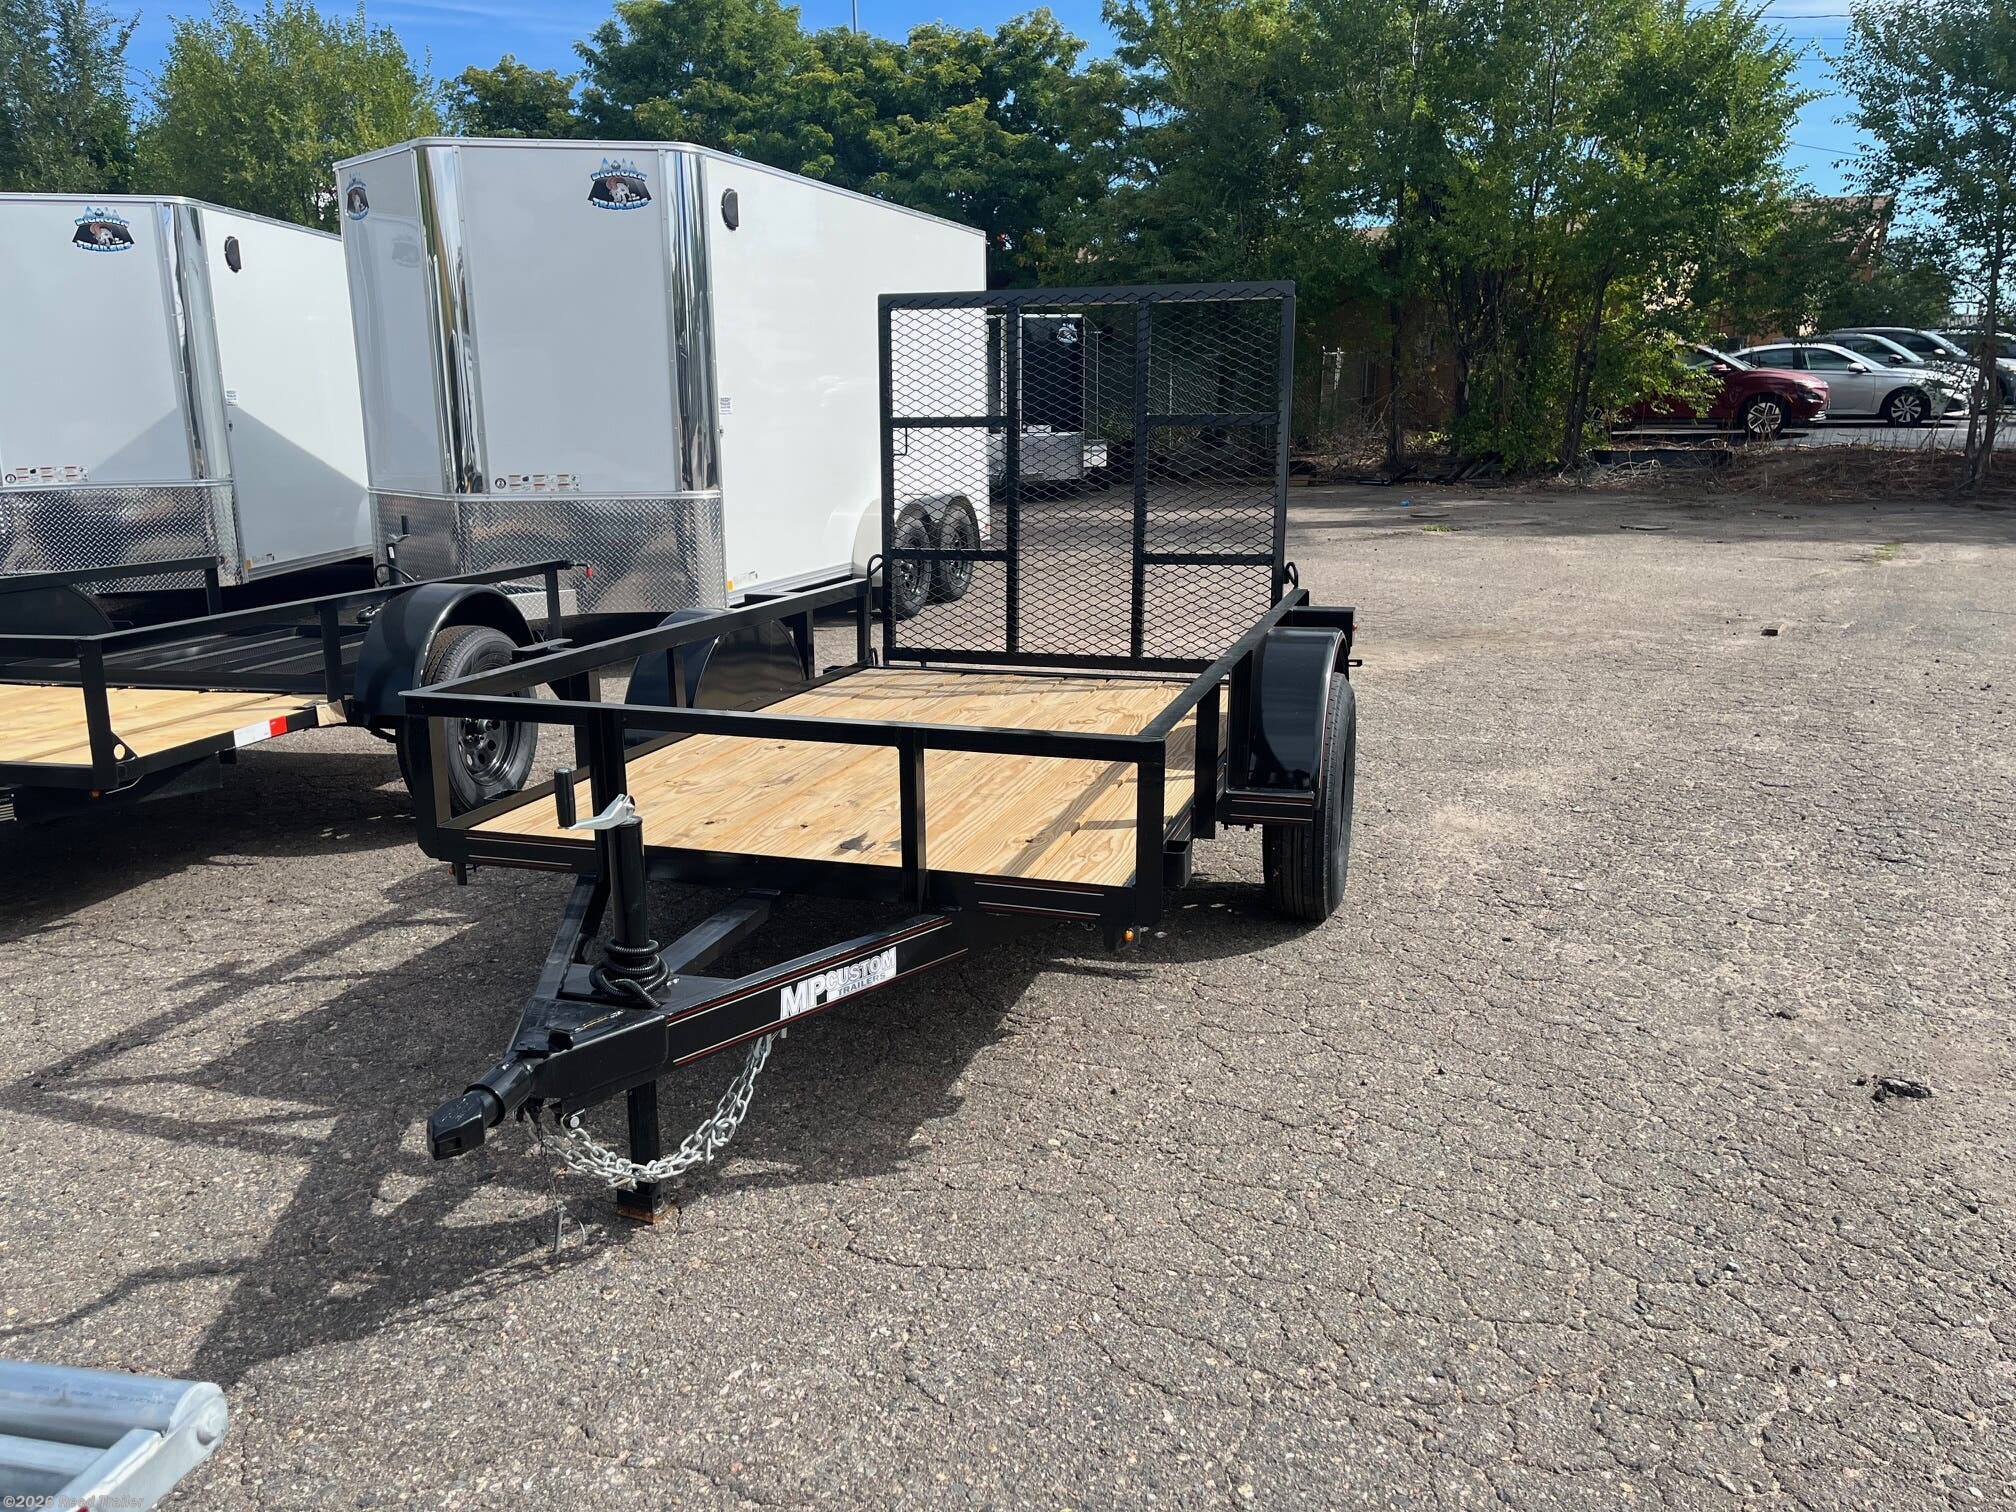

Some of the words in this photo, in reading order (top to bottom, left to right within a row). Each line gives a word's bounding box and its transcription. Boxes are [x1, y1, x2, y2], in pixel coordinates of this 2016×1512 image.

[592, 197, 650, 211] TRAILERS
[76, 240, 132, 252] TRAILERS
[824, 946, 897, 988] CUSTOM
[838, 973, 886, 996] TRAILERS
